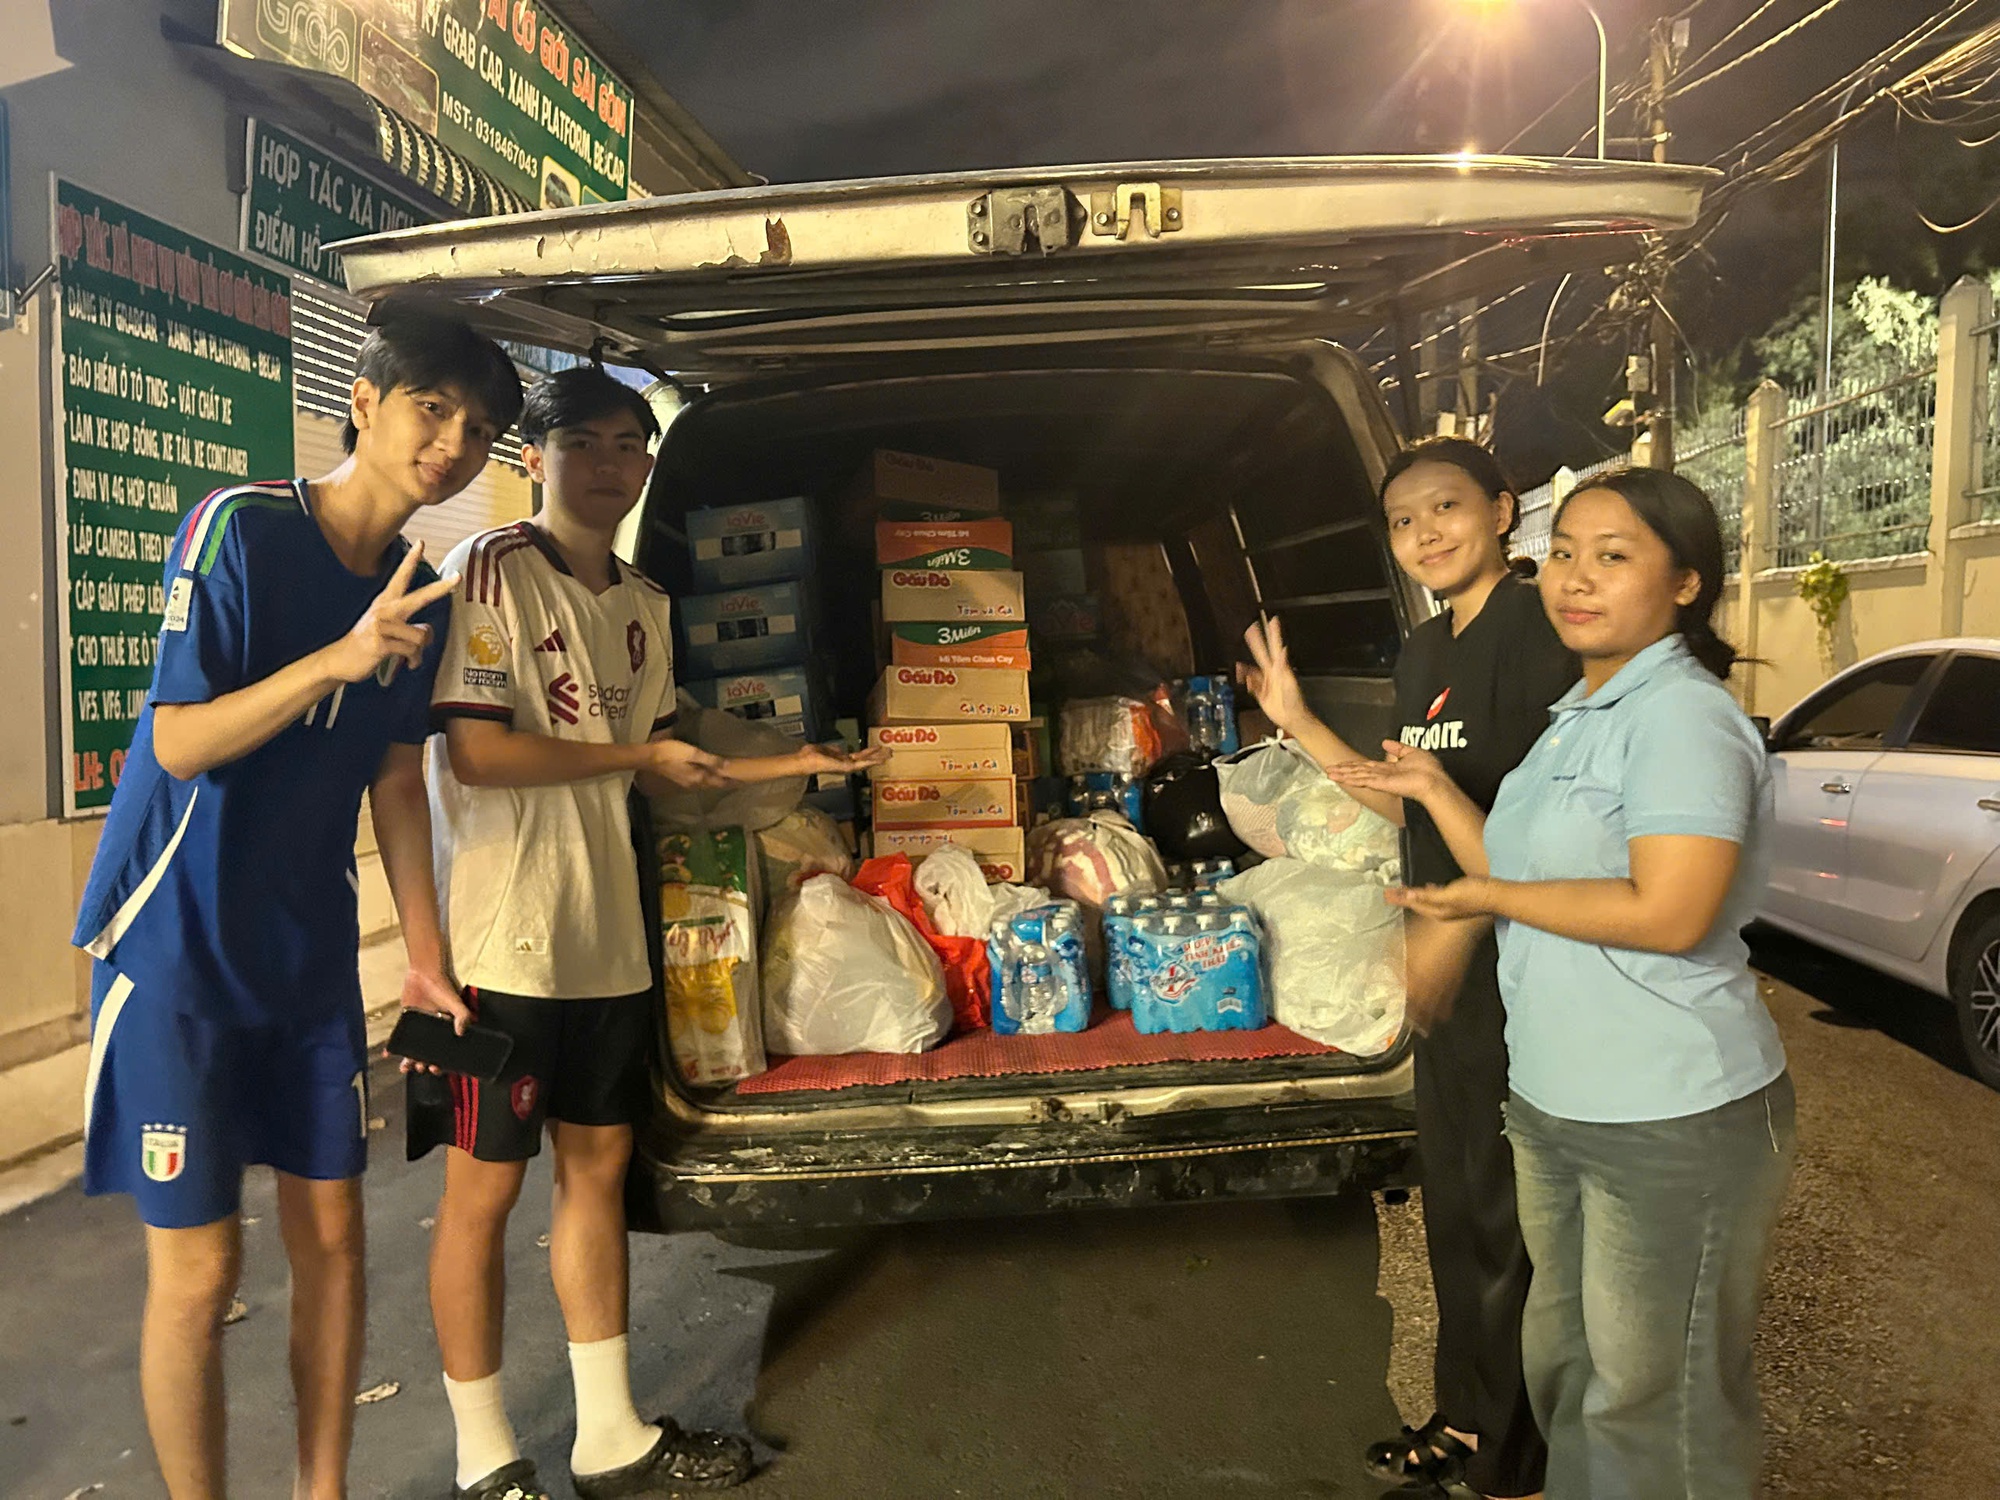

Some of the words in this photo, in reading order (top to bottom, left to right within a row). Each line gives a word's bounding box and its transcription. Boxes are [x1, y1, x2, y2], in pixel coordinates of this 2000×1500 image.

[262, 0, 350, 72] Grab
[443, 13, 476, 70] GRAB
[479, 44, 504, 97] CAR,
[508, 68, 540, 121] XANH
[541, 95, 592, 166] PLATFORM,
[512, 2, 537, 53] CƠ
[540, 27, 570, 87] GIỚI
[572, 56, 596, 111] SÀI
[599, 80, 627, 137] GÒN
[442, 91, 472, 132] MST:
[475, 117, 538, 178] 0318467043
[260, 135, 300, 193] HỢP
[308, 161, 343, 214] TÁC
[349, 183, 373, 230] XÃ
[255, 204, 295, 263] ĐIỂM
[301, 224, 321, 272] HỖ
[69, 347, 91, 389] BẢO
[94, 351, 118, 396] HIỂM
[120, 362, 127, 398] Ô
[130, 367, 143, 402] TÔ
[146, 375, 168, 409] TNDS
[178, 380, 196, 421] VẬT
[199, 385, 220, 423] CHẤT
[222, 396, 232, 426] XE
[70, 404, 93, 446] LÀM
[96, 416, 109, 449] XE
[111, 420, 130, 458] HỢP
[162, 432, 173, 462] XE
[194, 439, 205, 469] XE
[206, 442, 248, 477] CONTAINER
[73, 467, 96, 506] ĐỊNH
[99, 471, 110, 510] VỊ
[112, 475, 125, 505] 4G
[126, 476, 145, 514] HỢP
[73, 512, 93, 555] LẮP
[96, 526, 137, 560] CAMERA
[139, 531, 162, 562] THEO
[75, 570, 95, 611] CẤP
[98, 572, 120, 612] GIẤY
[123, 577, 146, 613] PHÉP
[893, 571, 927, 587] Gấu
[77, 634, 98, 667] CHO
[101, 631, 125, 667] THUÊ
[128, 637, 139, 666] XE
[142, 631, 150, 667] Ô
[898, 668, 932, 685] Gấu
[933, 670, 956, 685] Đỏ
[879, 728, 913, 744] Gấu
[914, 728, 938, 743] Đỏ
[1441, 720, 1467, 748] IT.
[74, 750, 104, 792] LH:
[110, 749, 130, 787] 0
[881, 786, 916, 801] Gấu
[918, 786, 940, 801] Đỏ
